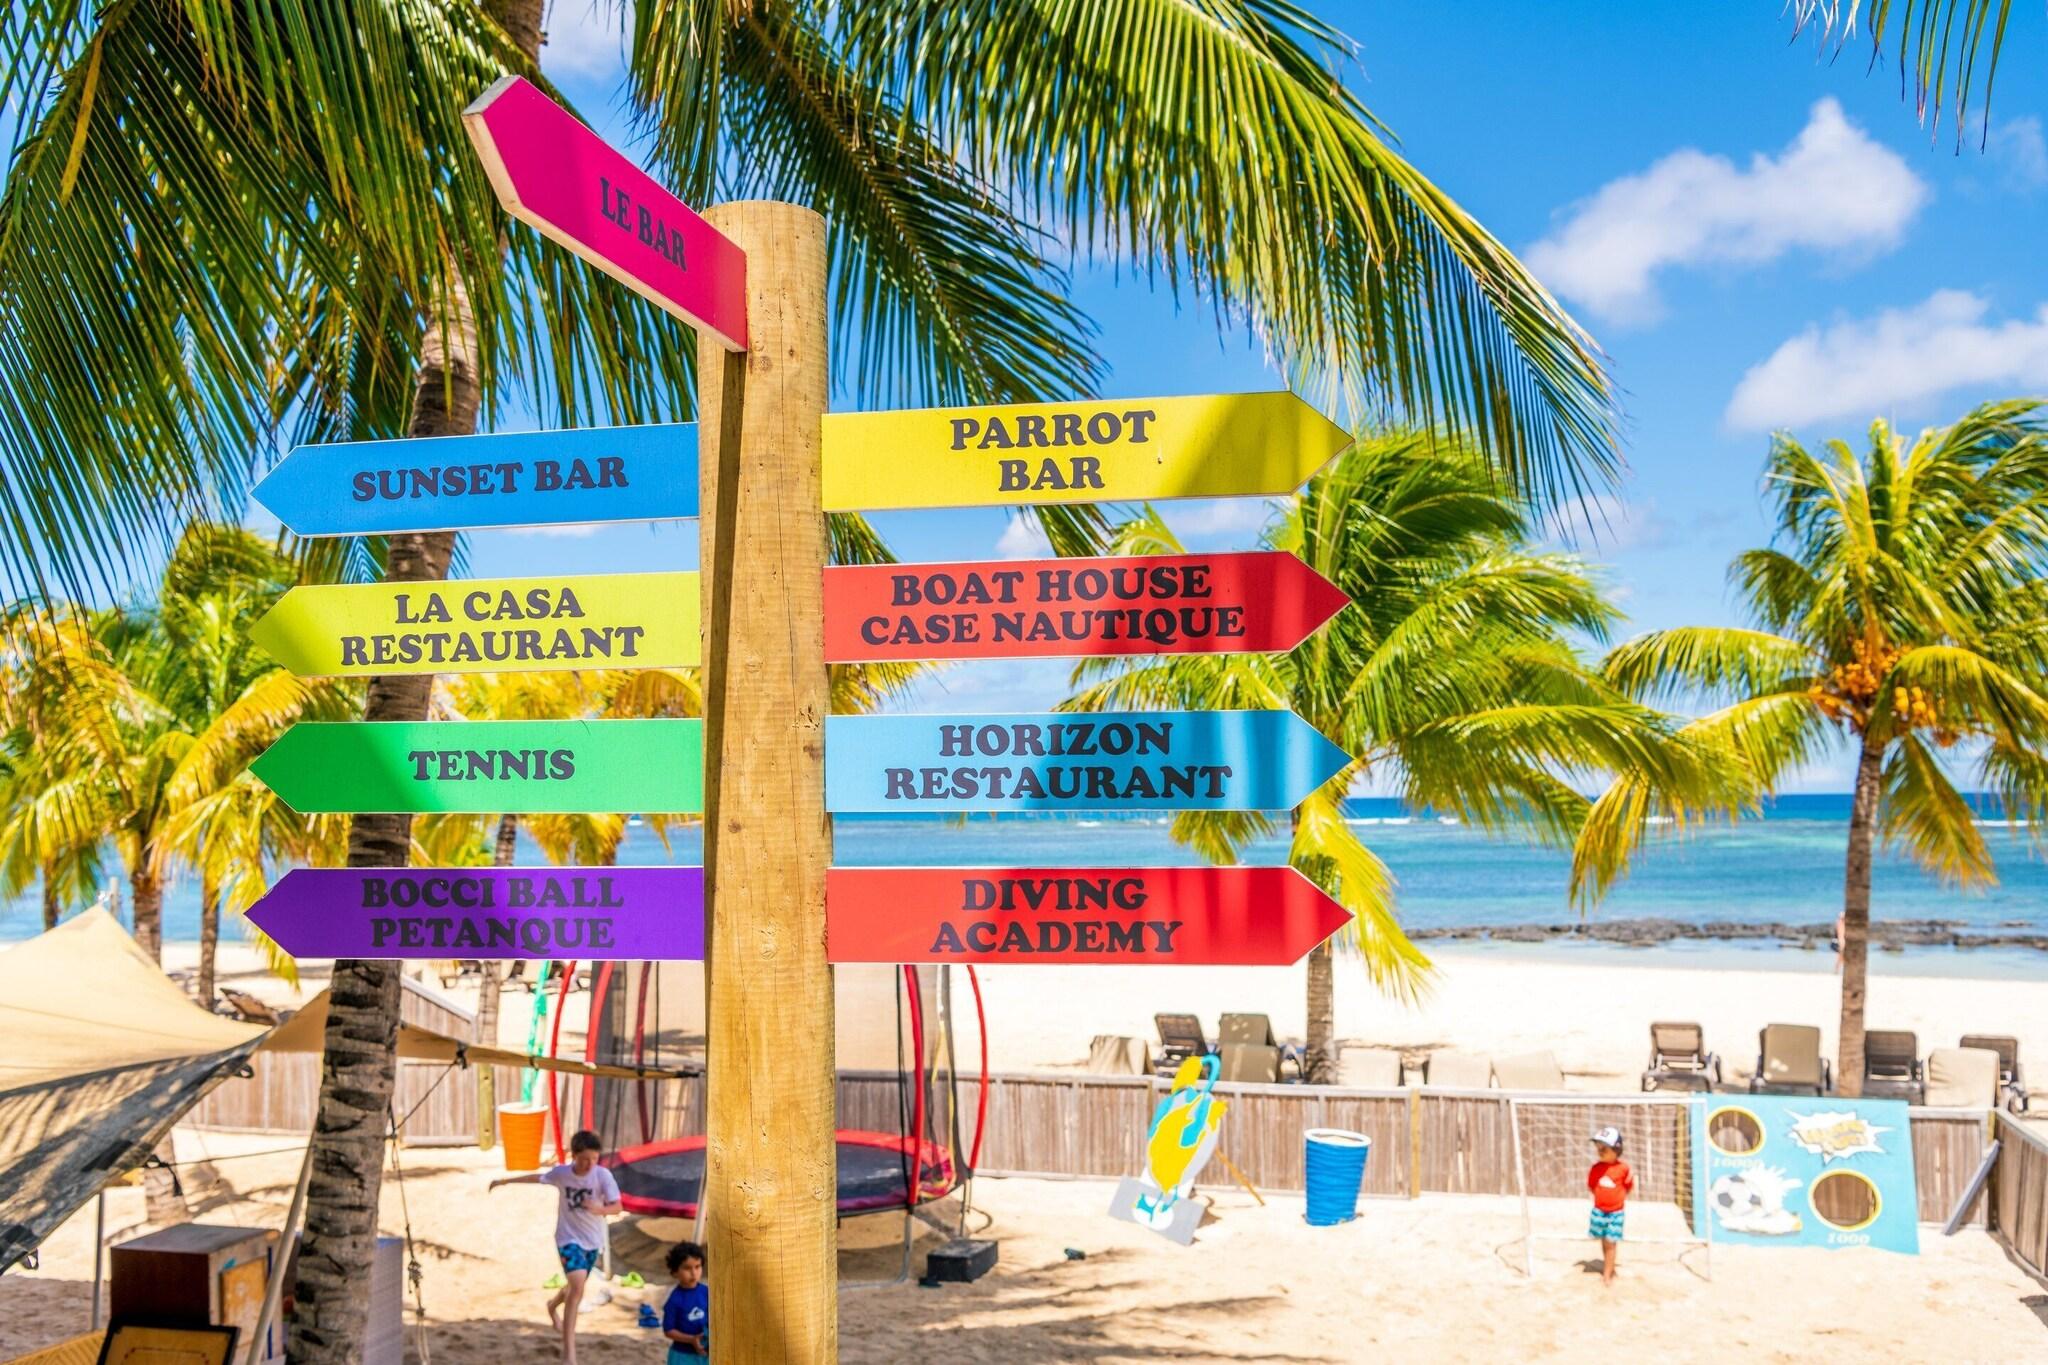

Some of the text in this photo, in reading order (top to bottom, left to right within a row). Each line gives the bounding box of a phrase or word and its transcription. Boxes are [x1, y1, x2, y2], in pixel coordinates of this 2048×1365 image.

[600, 176, 687, 272] LE BAR
[949, 409, 1156, 451] PARROT
[352, 456, 629, 502] SUNSET BAR
[998, 456, 1106, 492] BAR
[891, 564, 1213, 607] BOAT HOUSE
[394, 587, 586, 625] LA CASA
[860, 606, 1246, 646] CASE NAUTIQUE
[340, 625, 645, 666] RESTAURANT
[938, 722, 1174, 757] HORIZON
[407, 749, 576, 781] TENNIS
[884, 765, 1233, 800] RESTAURANT
[361, 877, 625, 908] BOCCI BALL
[962, 878, 1149, 911] DIVING
[370, 917, 616, 953] PETANQUE
[929, 921, 1184, 953] ACADEMY
[1827, 1232, 1871, 1245] 1000
